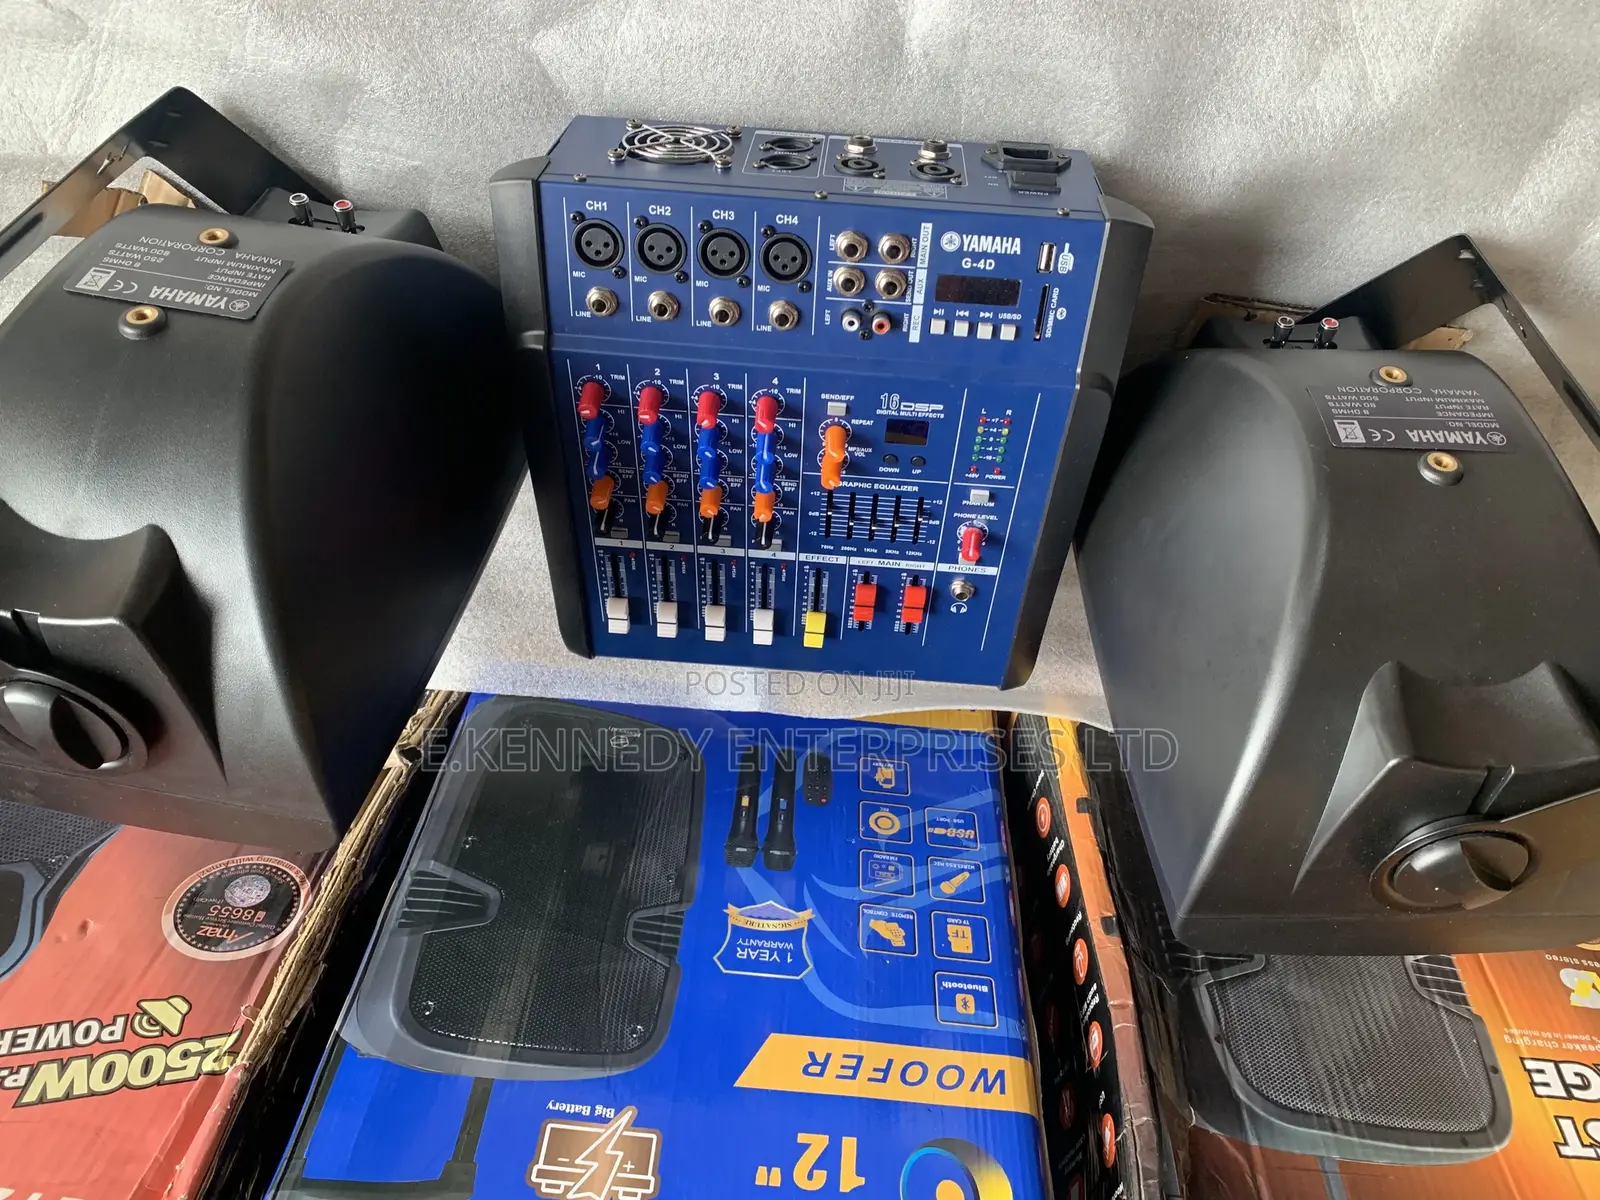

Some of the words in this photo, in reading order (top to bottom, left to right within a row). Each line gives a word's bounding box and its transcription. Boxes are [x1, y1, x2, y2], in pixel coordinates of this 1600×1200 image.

[586, 200, 608, 212] CH1
[648, 205, 671, 216] CH2
[712, 209, 735, 220] CH3
[776, 214, 798, 225] CH4
[921, 226, 930, 241] OUT
[115, 242, 149, 253] WATTS
[139, 236, 225, 256] CORPORATION
[962, 234, 1021, 255] YAMAHA
[108, 250, 142, 260] WATTS
[147, 256, 165, 264] 250
[235, 251, 282, 266] YAMAHA
[919, 244, 928, 265] MAIN
[102, 256, 132, 266] OHMS
[194, 256, 225, 266] INPUT
[226, 260, 277, 274] MAXIMUM
[961, 258, 995, 270] G-4D
[1059, 254, 1068, 273] USB
[214, 267, 247, 277] INPUT
[250, 272, 271, 281] RATE
[207, 274, 266, 288] IMPEDANCE
[204, 284, 221, 292] NO:
[224, 286, 259, 298] MODEL
[149, 285, 229, 310] YAMAHA
[1051, 288, 1059, 308] CARD
[772, 377, 779, 385] 4
[1337, 386, 1422, 395] CORPORATION
[880, 393, 900, 410] 16
[900, 402, 944, 412] DSP
[1406, 429, 1488, 445] YAMAHA
[874, 482, 918, 492] EQUALIZER
[946, 826, 975, 840] USB
[949, 862, 975, 870] WIRELESS
[207, 904, 254, 920] 8655
[863, 908, 888, 917] CONTROL
[890, 912, 913, 920] REMOTE
[744, 919, 792, 930] SIGNATURE
[951, 930, 969, 939] TF
[737, 938, 793, 950] WARRANTY
[736, 947, 781, 962] YEAR
[786, 951, 793, 963] 1
[1545, 953, 1580, 965] stereo
[942, 981, 989, 992] Bluetooth
[1504, 1034, 1559, 1049] charging
[1564, 1032, 1590, 1042] power
[13, 1028, 243, 1108] 2500W
[801, 1050, 1006, 1095] WOOFER
[1521, 1058, 1600, 1102] GE
[546, 1100, 591, 1116] Battery
[595, 1104, 615, 1118] Big
[754, 1132, 866, 1193] 12"
